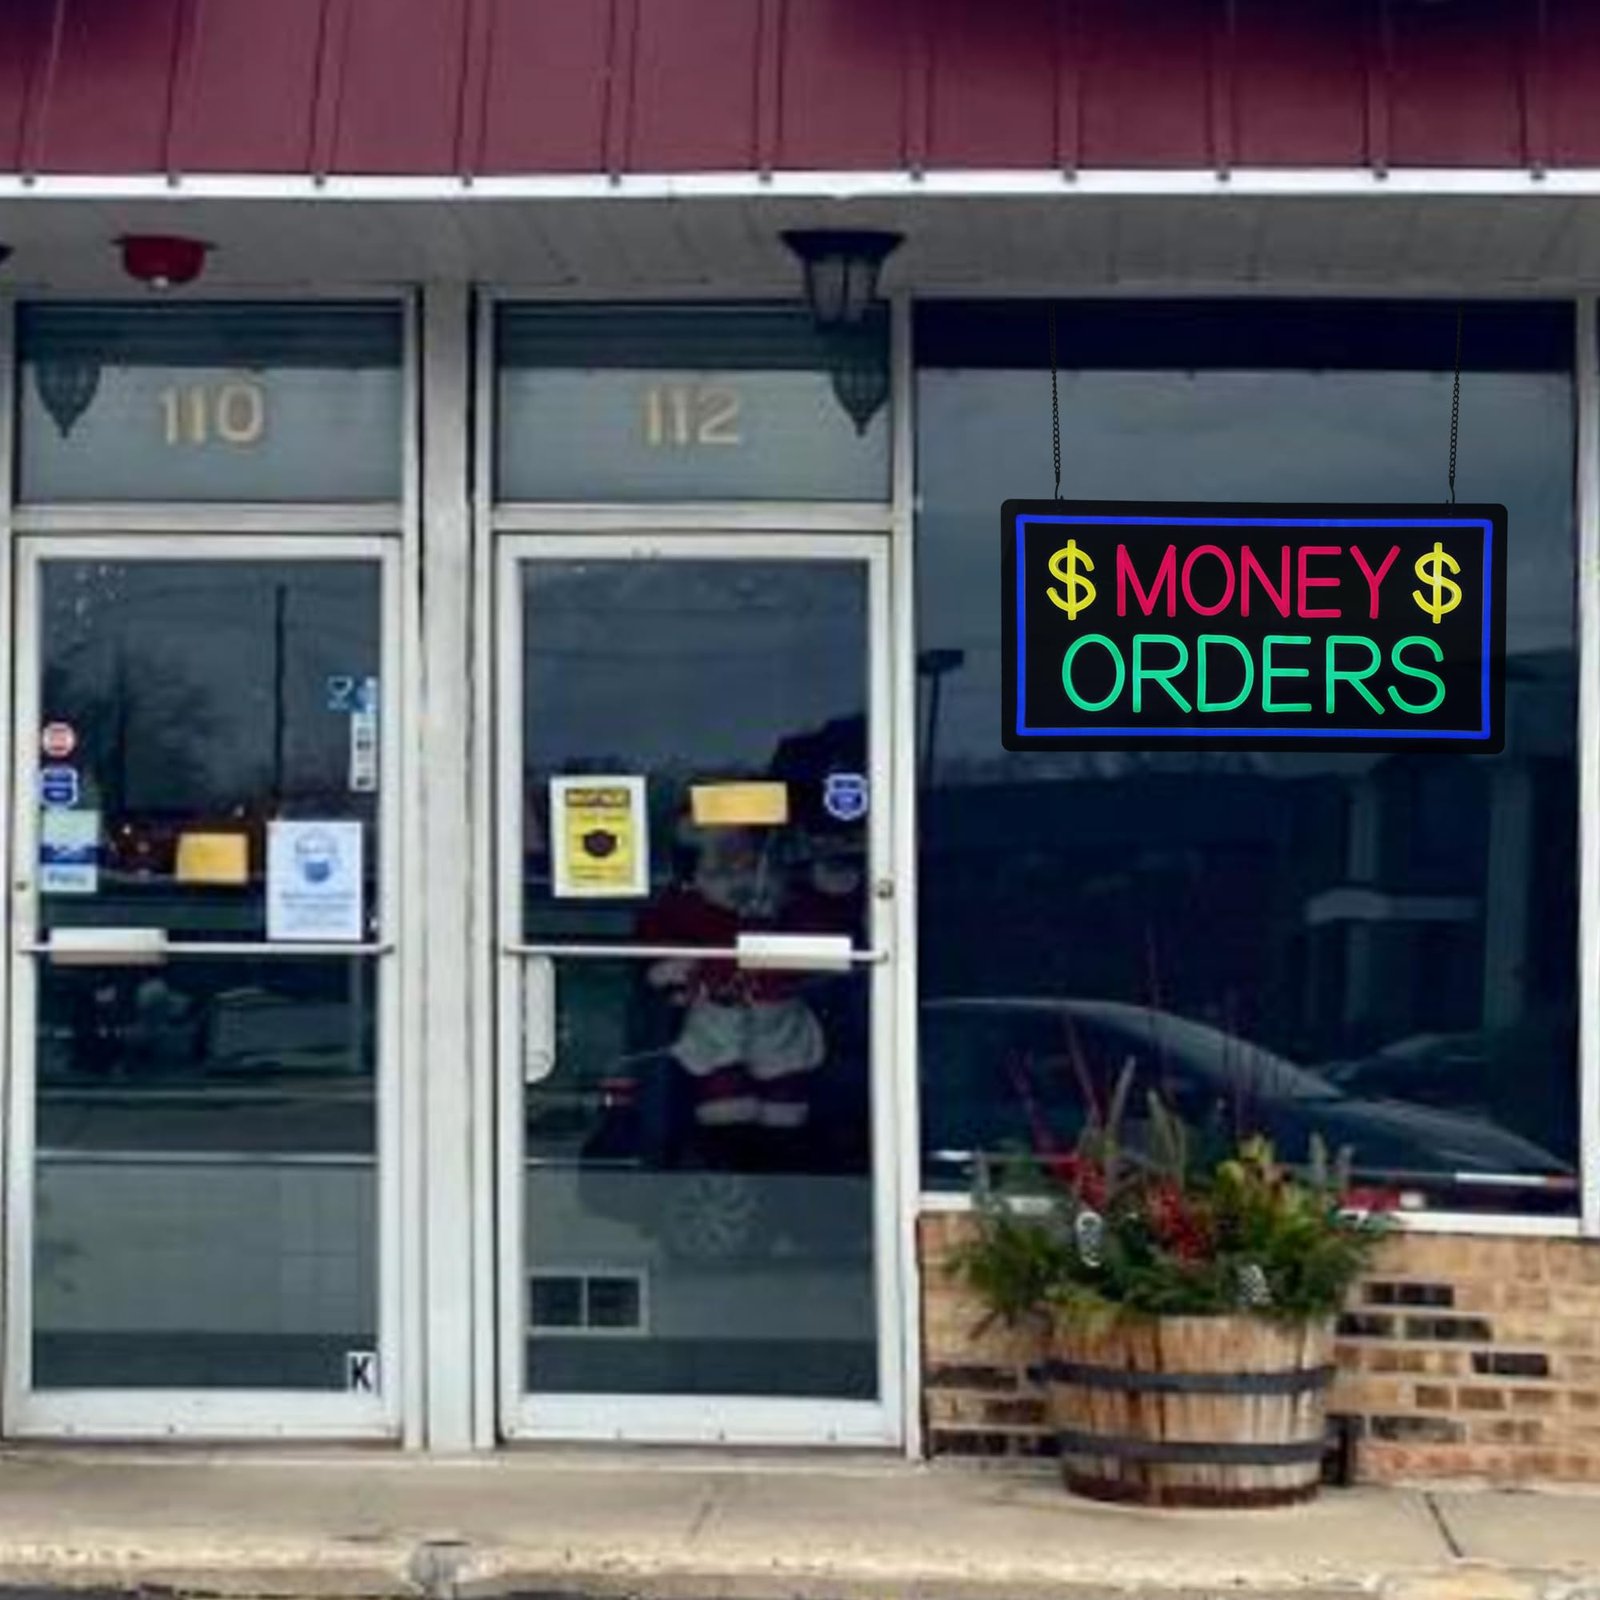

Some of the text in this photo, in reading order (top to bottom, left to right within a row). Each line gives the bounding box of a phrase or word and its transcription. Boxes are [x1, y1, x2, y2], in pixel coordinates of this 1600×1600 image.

[159, 384, 264, 445] 110
[643, 386, 740, 446] 112
[1116, 543, 1400, 619] MONEY
[1062, 633, 1446, 714] ORDERS
[351, 1355, 371, 1391] K
